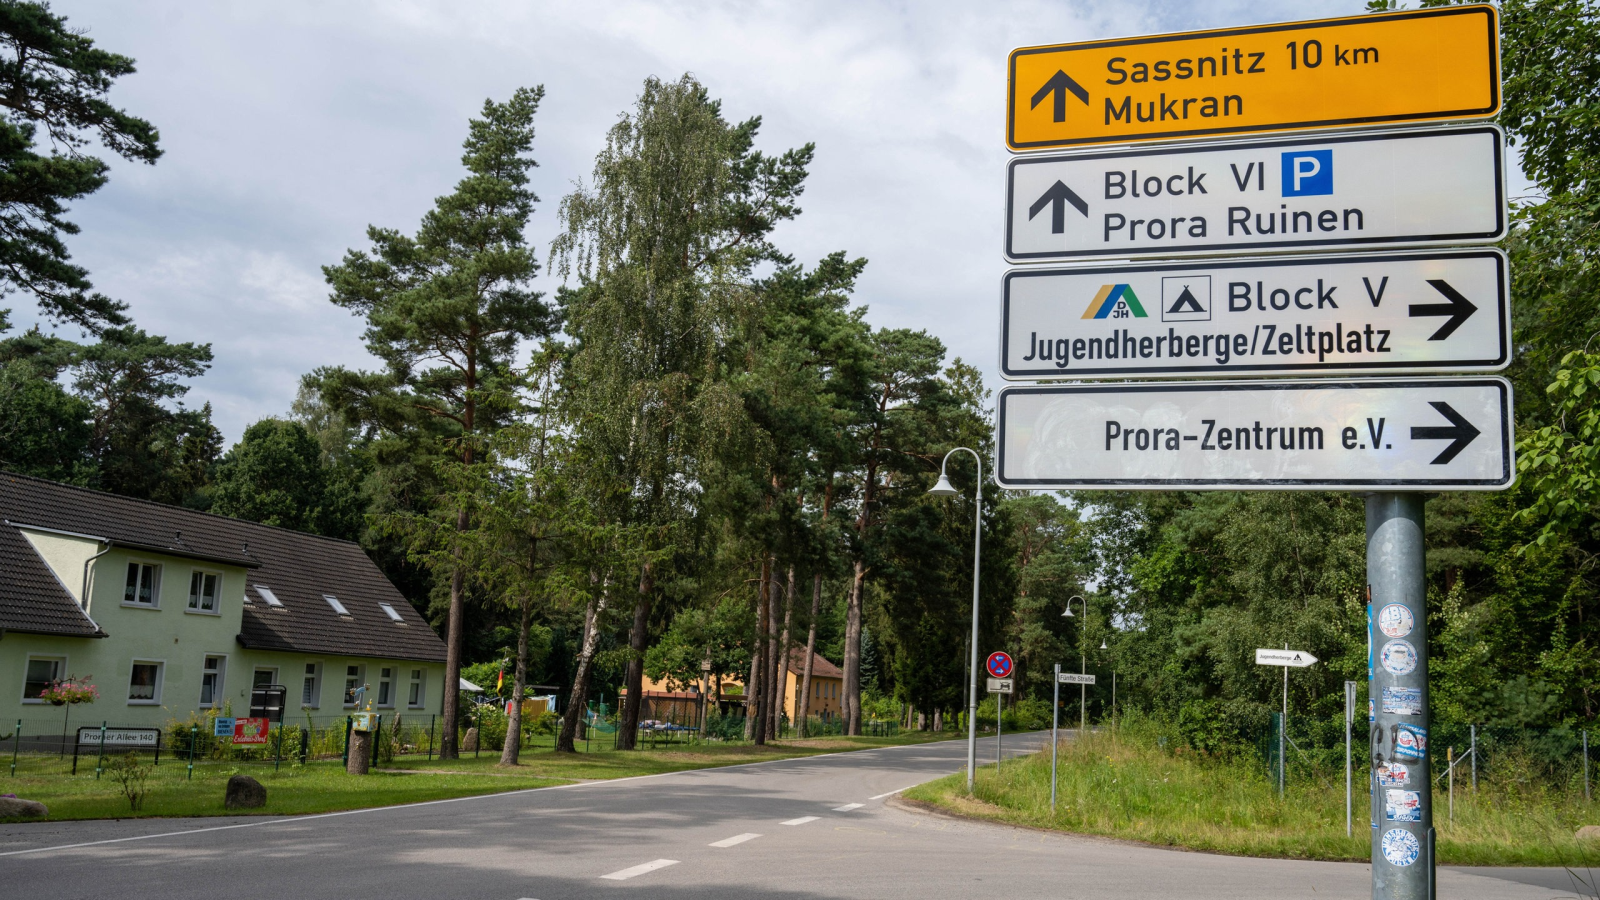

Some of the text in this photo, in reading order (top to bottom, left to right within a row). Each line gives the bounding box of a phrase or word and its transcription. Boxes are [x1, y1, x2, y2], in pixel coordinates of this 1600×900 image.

[1105, 39, 1379, 86] Sassnitz 10 km
[1104, 93, 1243, 126] Mukran
[1104, 156, 1321, 200] Block VI P
[1103, 204, 1364, 242] Prora Ruinen
[1228, 276, 1389, 313] Block V
[1022, 323, 1392, 369] Jugendherberge/Zeltplatz
[1105, 417, 1392, 451] Prora-Zentrum e.V.
